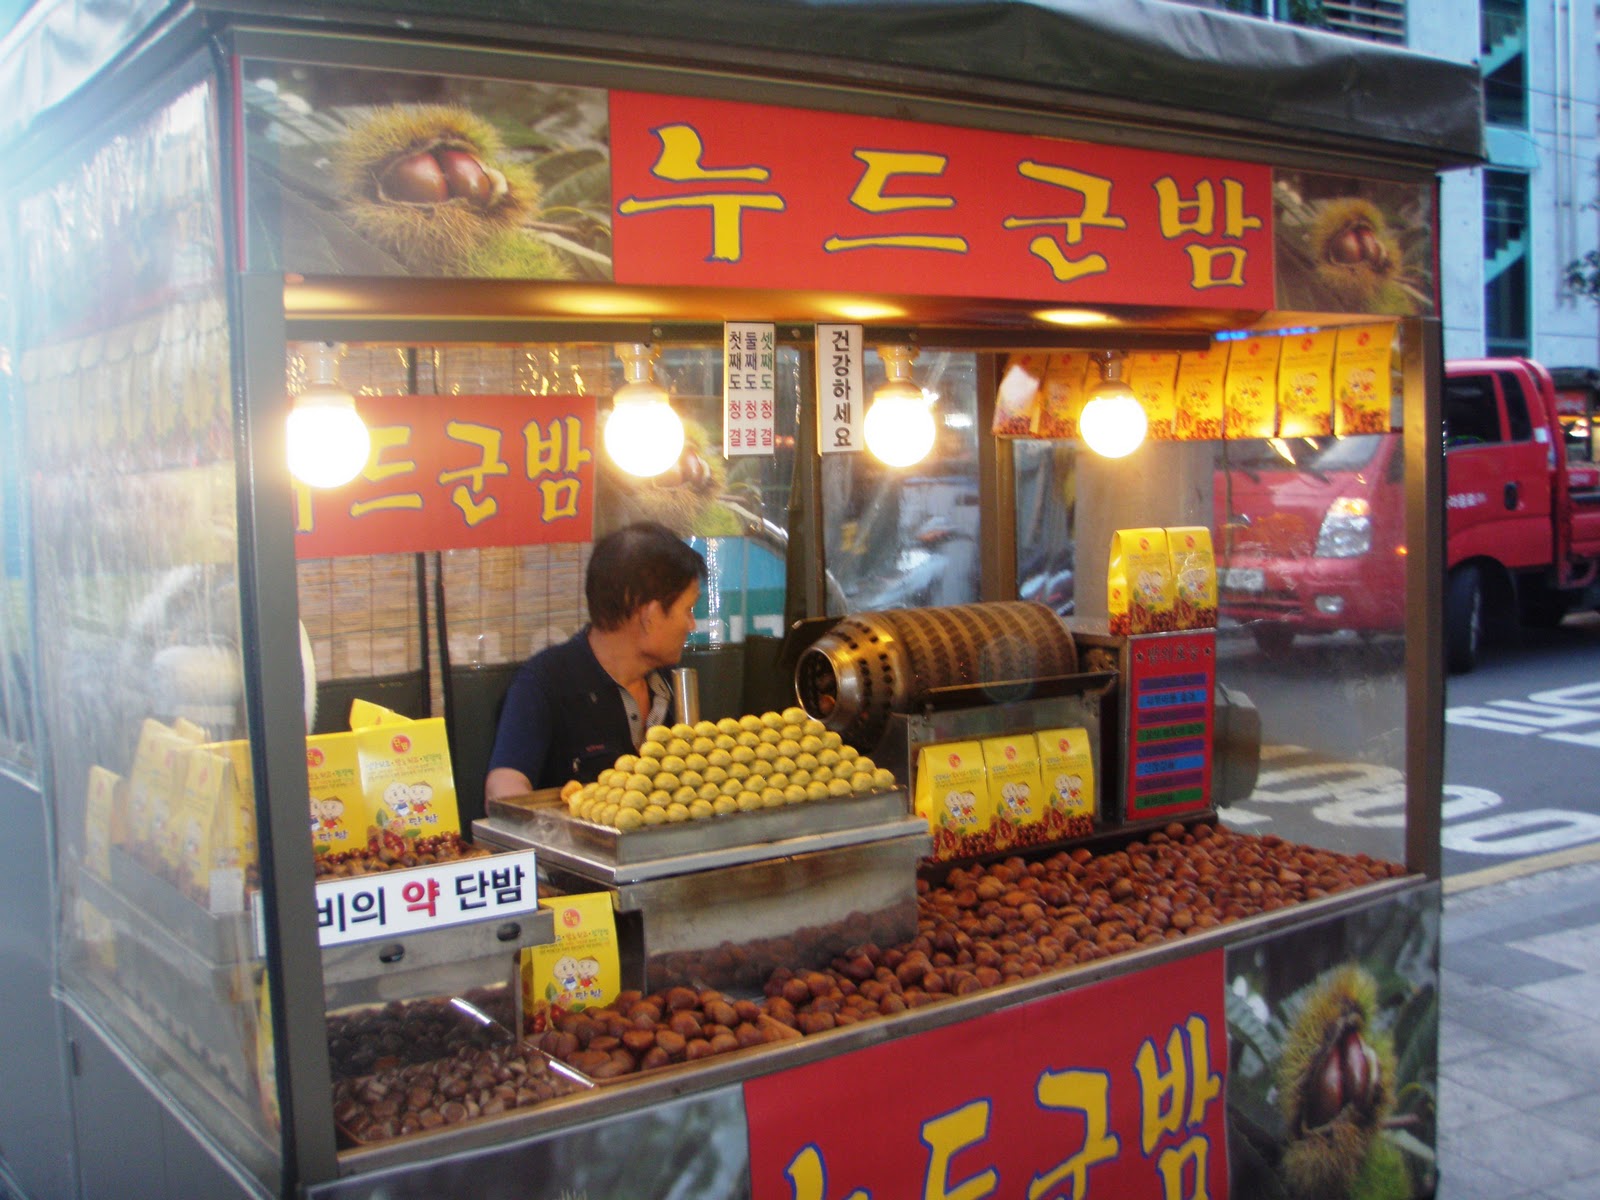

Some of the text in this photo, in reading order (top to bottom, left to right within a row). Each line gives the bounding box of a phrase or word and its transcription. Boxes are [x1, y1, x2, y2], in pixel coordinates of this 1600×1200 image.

[728, 330, 742, 447] 첫째도 청결
[744, 331, 757, 447] 둘째도 청결
[760, 331, 773, 447] 셋째도 청결
[832, 329, 852, 447] 건강하세요
[294, 414, 592, 533] 드군밤
[401, 877, 440, 917] 약
[455, 864, 525, 911] 단밤
